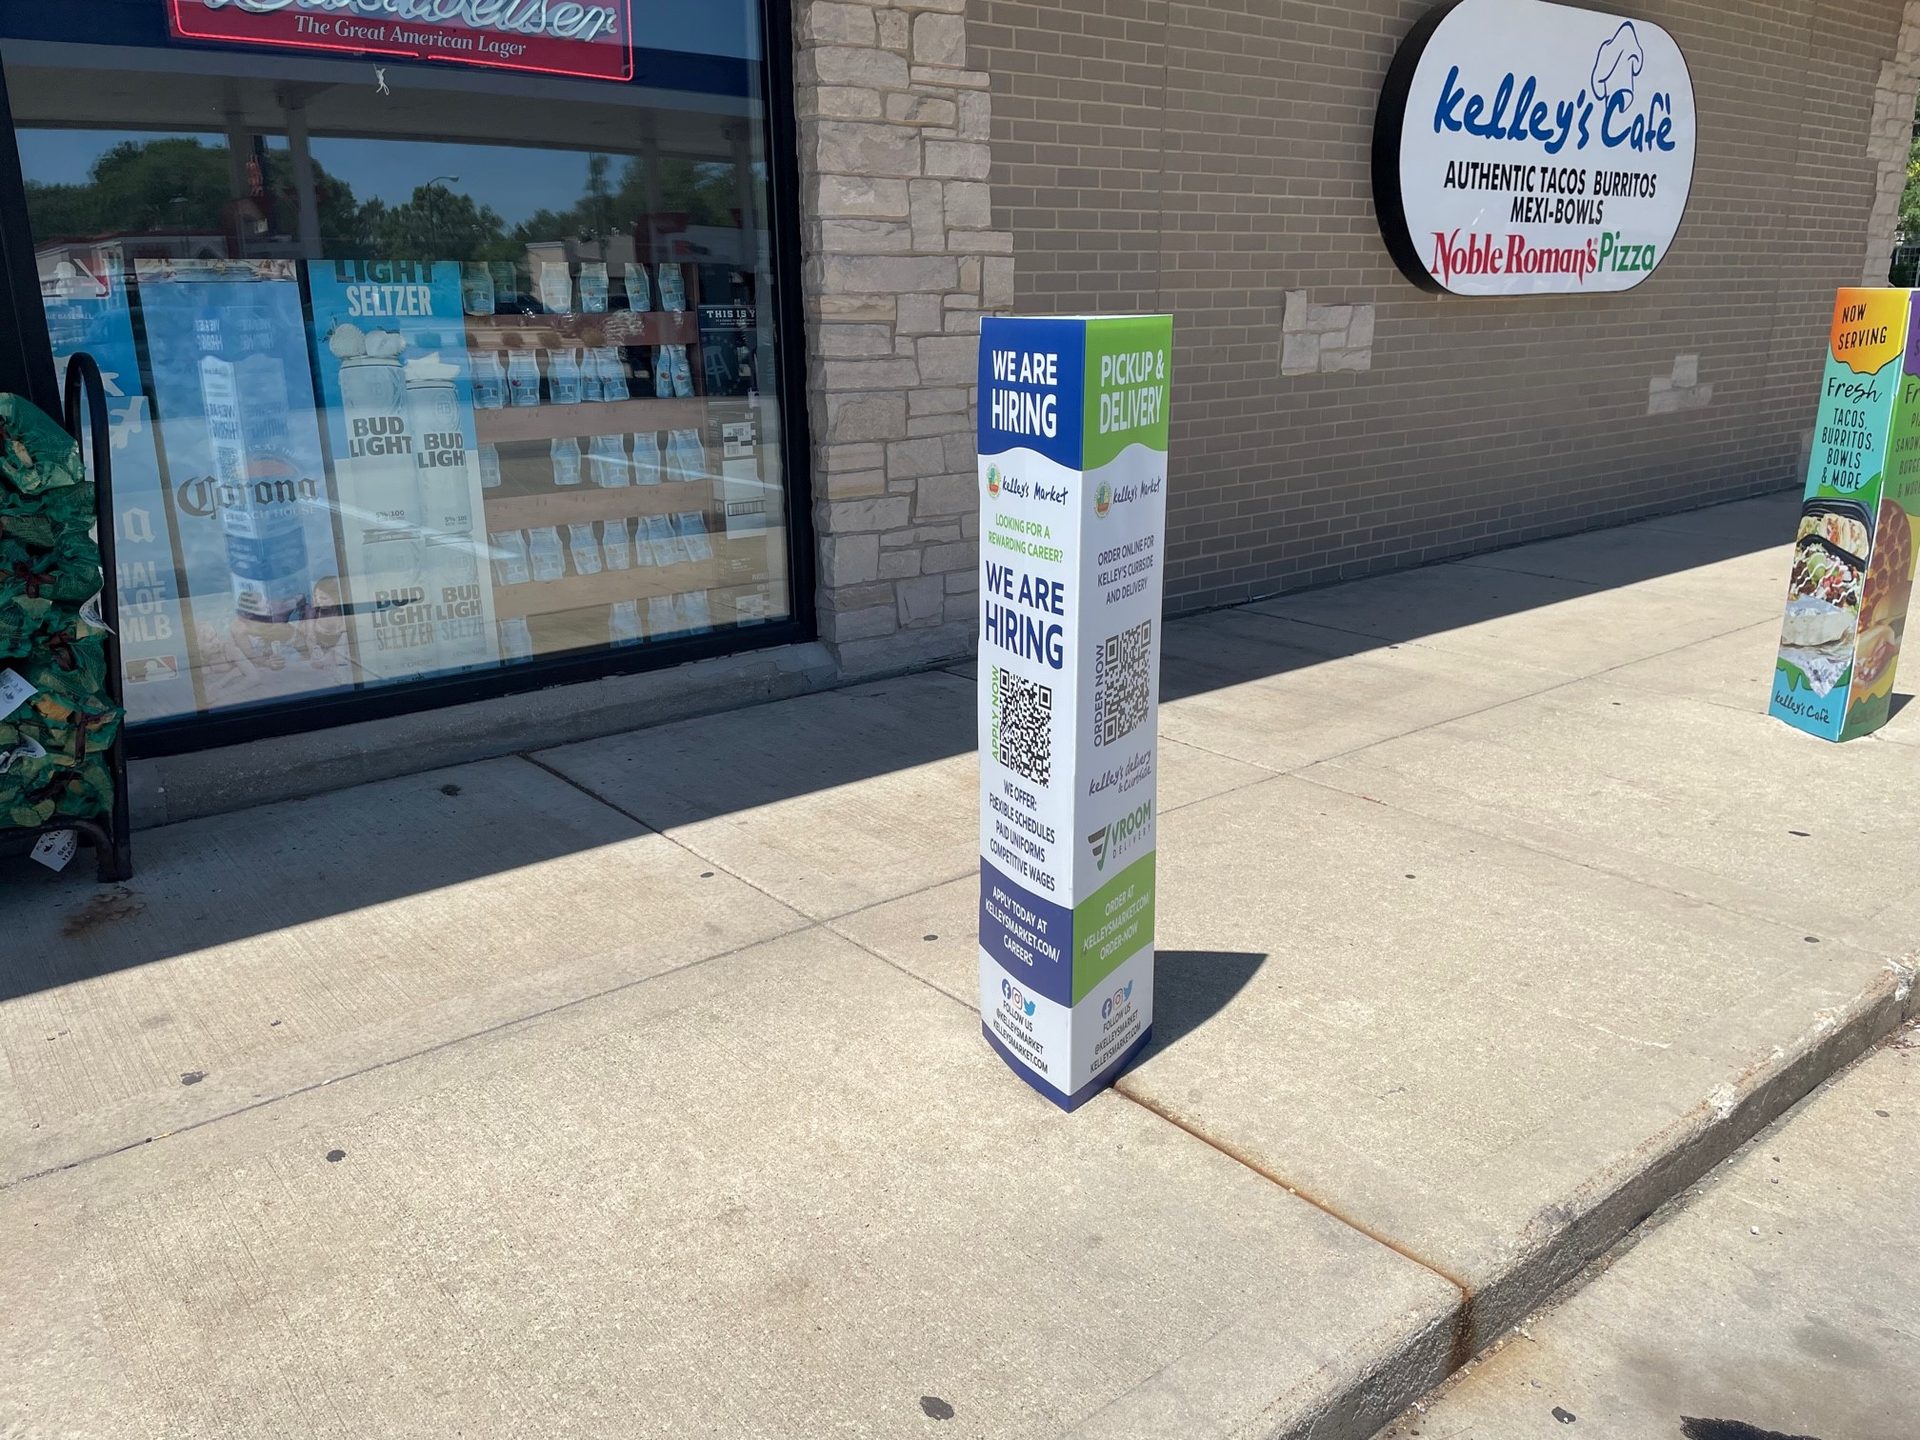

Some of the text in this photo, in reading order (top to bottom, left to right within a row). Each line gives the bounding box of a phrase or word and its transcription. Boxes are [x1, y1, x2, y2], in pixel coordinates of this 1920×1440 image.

[295, 15, 527, 58] The Great American Lager
[1444, 160, 1657, 199] AUTHENTIC TACOS BURRITOS
[1510, 196, 1603, 225] MEXI-BOWLS
[334, 260, 433, 283] LIGHT
[1430, 228, 1656, 286] Noble Roman's Pizza
[347, 285, 433, 317] SELTZER
[706, 310, 733, 318] THIS
[736, 310, 747, 318] IS
[1841, 303, 1867, 324] NOW
[1838, 326, 1887, 350] SERVING
[992, 350, 1058, 386] WE ARE
[1101, 349, 1164, 387] PICKUP &
[1827, 377, 1883, 403] Fresh
[991, 388, 1057, 438] HIRING
[1100, 385, 1163, 434] DELIVERY
[1833, 408, 1867, 431] TACOS,
[353, 416, 405, 438] BUD
[424, 433, 463, 450] BUD
[1822, 426, 1874, 452] BURRITOS,
[349, 435, 412, 458] LIGHT
[417, 450, 466, 469] LIGH
[1827, 448, 1861, 469] BOWLS
[1033, 481, 1069, 505] Market
[1139, 476, 1161, 499] Market
[1821, 467, 1861, 490] & MORE
[177, 475, 318, 520] Corona
[995, 513, 1050, 539] LOOKING FOR A
[988, 531, 1063, 563] REWARDING CAREER?
[1097, 534, 1154, 566] ORDER ONLINE FOR
[1097, 554, 1153, 587] KELLEY'S CURBSIDE
[136, 587, 166, 614] OF
[375, 586, 425, 609] BUD
[442, 584, 480, 603] BUD
[986, 560, 1064, 616] WE ARE
[1106, 576, 1148, 605] AND DELIVERY
[372, 604, 432, 629] LIGHT
[436, 600, 482, 620] LIGH
[120, 614, 172, 643] MLB
[375, 622, 434, 651] SELTZER
[986, 600, 1063, 670] HIRING
[1094, 644, 1104, 747] ORDER NOW
[1004, 779, 1037, 811] WE OFFER:
[989, 792, 1055, 844] FLEXIBLE SCHEDULES
[1112, 800, 1151, 845] VROOM
[996, 819, 1045, 863] PAID UNIFORMS
[990, 838, 1055, 891] COMPETITIVE WAGES
[992, 886, 1048, 934] APPLY TODAY AT
[1105, 884, 1134, 916] ORDER AT
[986, 898, 1060, 963] KELLEYSMARKET.COM/
[1100, 921, 1138, 960] ORDER-NOW
[1004, 935, 1033, 966] CAREERS
[996, 1008, 1043, 1055] @KELLEYSMARKET
[1003, 1000, 1033, 1032] FOLLOW US
[1103, 1002, 1131, 1033] FOLLOW US
[993, 1019, 1048, 1074] KELLEYSMARKET.COM
[1090, 1021, 1141, 1073] KELLEYSMARKET.COM
[1094, 1010, 1138, 1055] @KELLEYSMARKET
